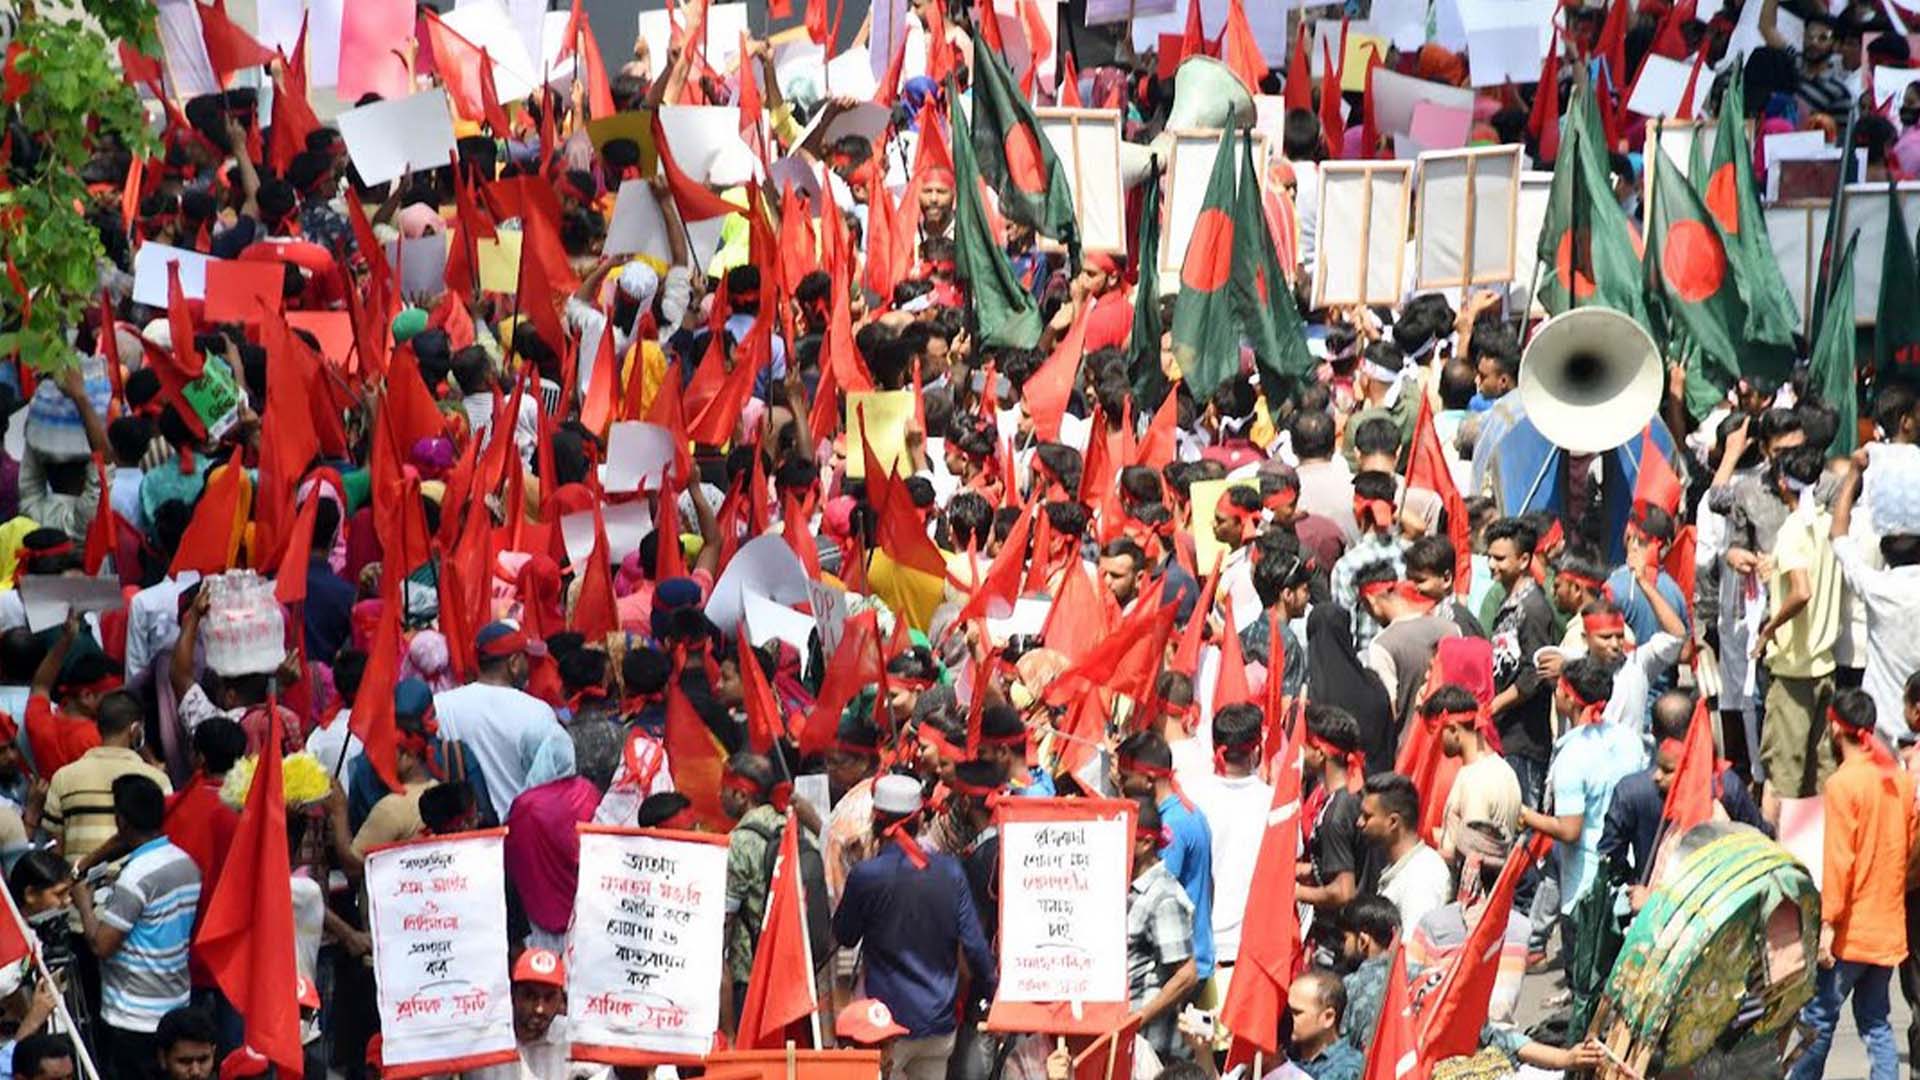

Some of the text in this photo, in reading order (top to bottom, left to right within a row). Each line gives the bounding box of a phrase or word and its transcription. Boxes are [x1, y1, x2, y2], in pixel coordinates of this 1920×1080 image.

[424, 957, 455, 979] কর
[625, 969, 660, 989] কর
[395, 991, 444, 1021] শ্রমিক
[584, 991, 640, 1018] শ্রমিক
